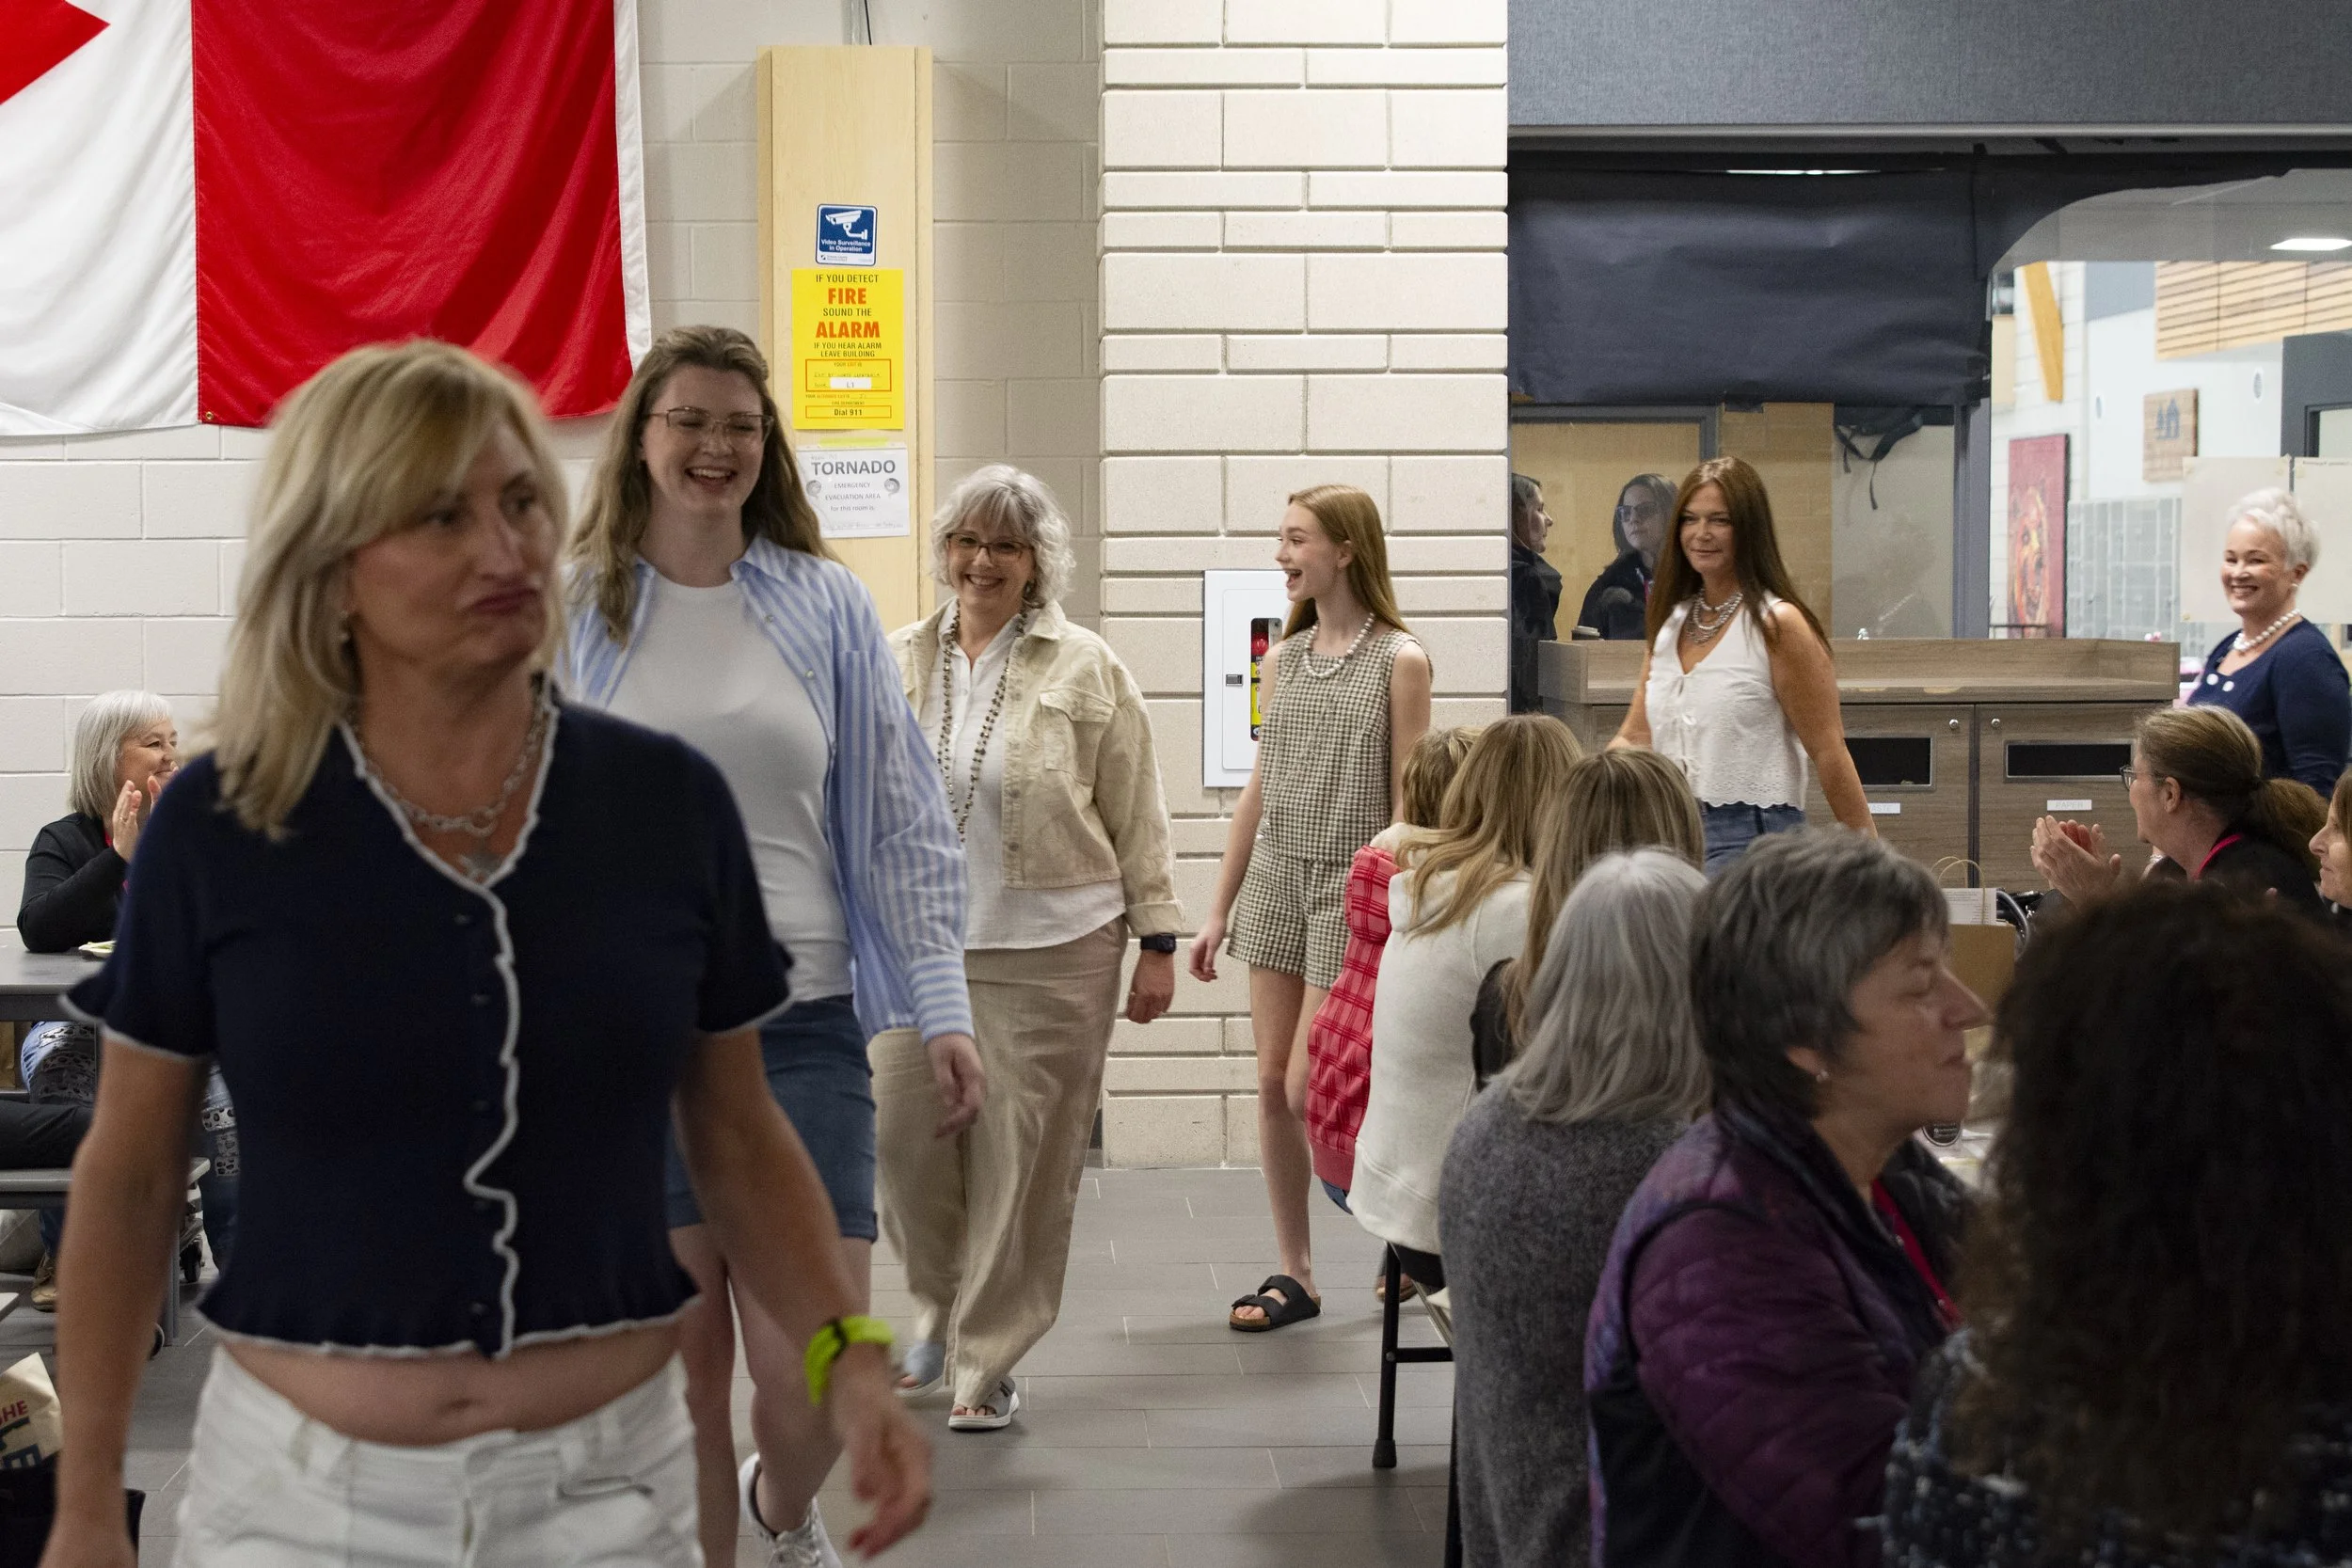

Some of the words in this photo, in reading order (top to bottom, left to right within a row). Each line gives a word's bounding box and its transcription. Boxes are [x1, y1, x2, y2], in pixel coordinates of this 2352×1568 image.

[816, 274, 823, 283] IF
[827, 274, 844, 283] YOU
[847, 274, 879, 283] DETECT
[828, 288, 866, 305] FIRE
[823, 308, 853, 316] SOUND
[856, 308, 872, 316] THE
[816, 321, 881, 338] ALARM
[811, 459, 896, 476] TORNADO
